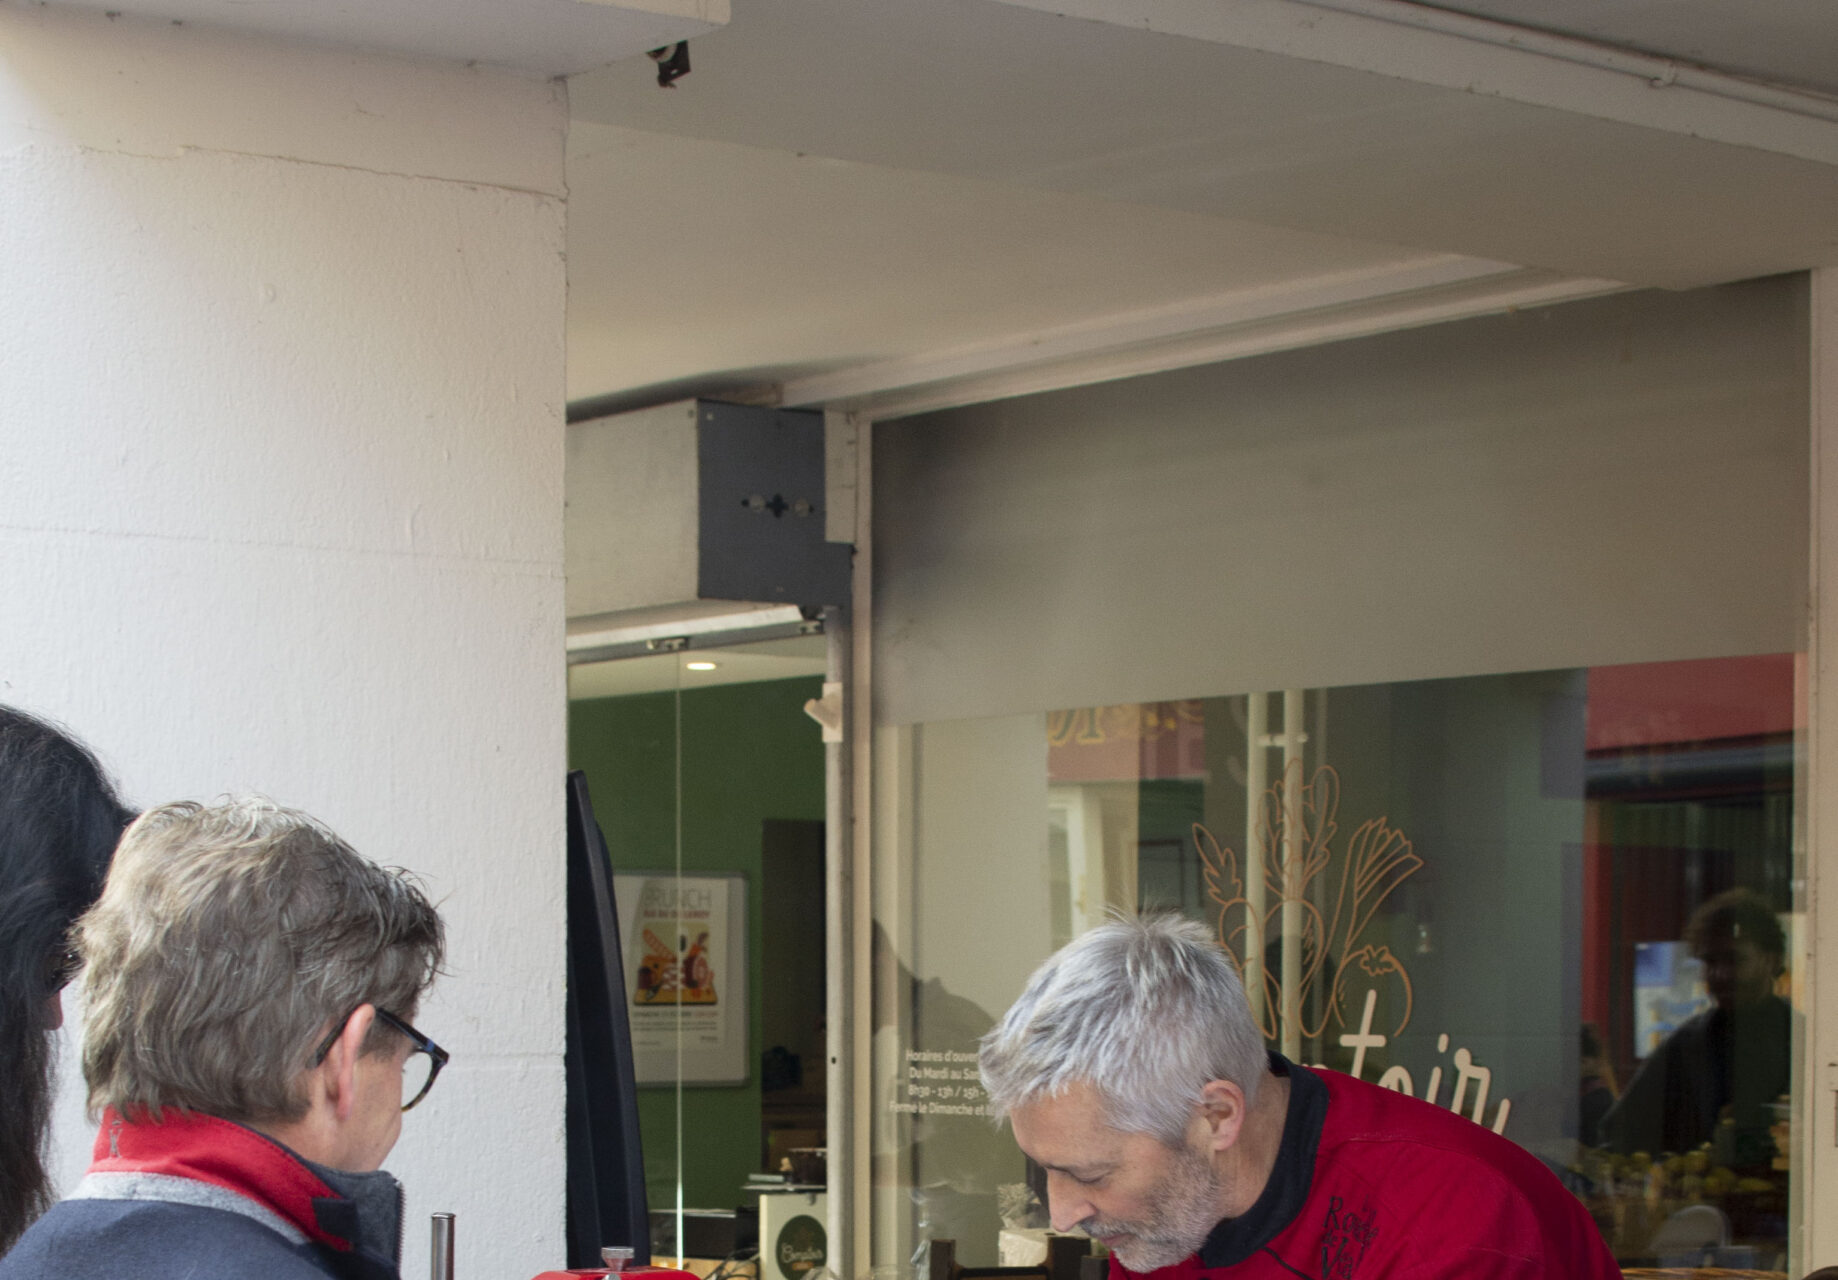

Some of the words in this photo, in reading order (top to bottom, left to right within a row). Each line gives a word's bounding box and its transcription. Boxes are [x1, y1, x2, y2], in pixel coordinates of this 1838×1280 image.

[905, 1049, 943, 1061] Horaires
[944, 1049, 979, 1062] d'ouver
[909, 1066, 921, 1078] Du
[923, 1067, 949, 1079] Mardi
[950, 1070, 962, 1079] au
[918, 1101, 928, 1113] le
[929, 1102, 974, 1115] Dimanche
[975, 1105, 985, 1115] et
